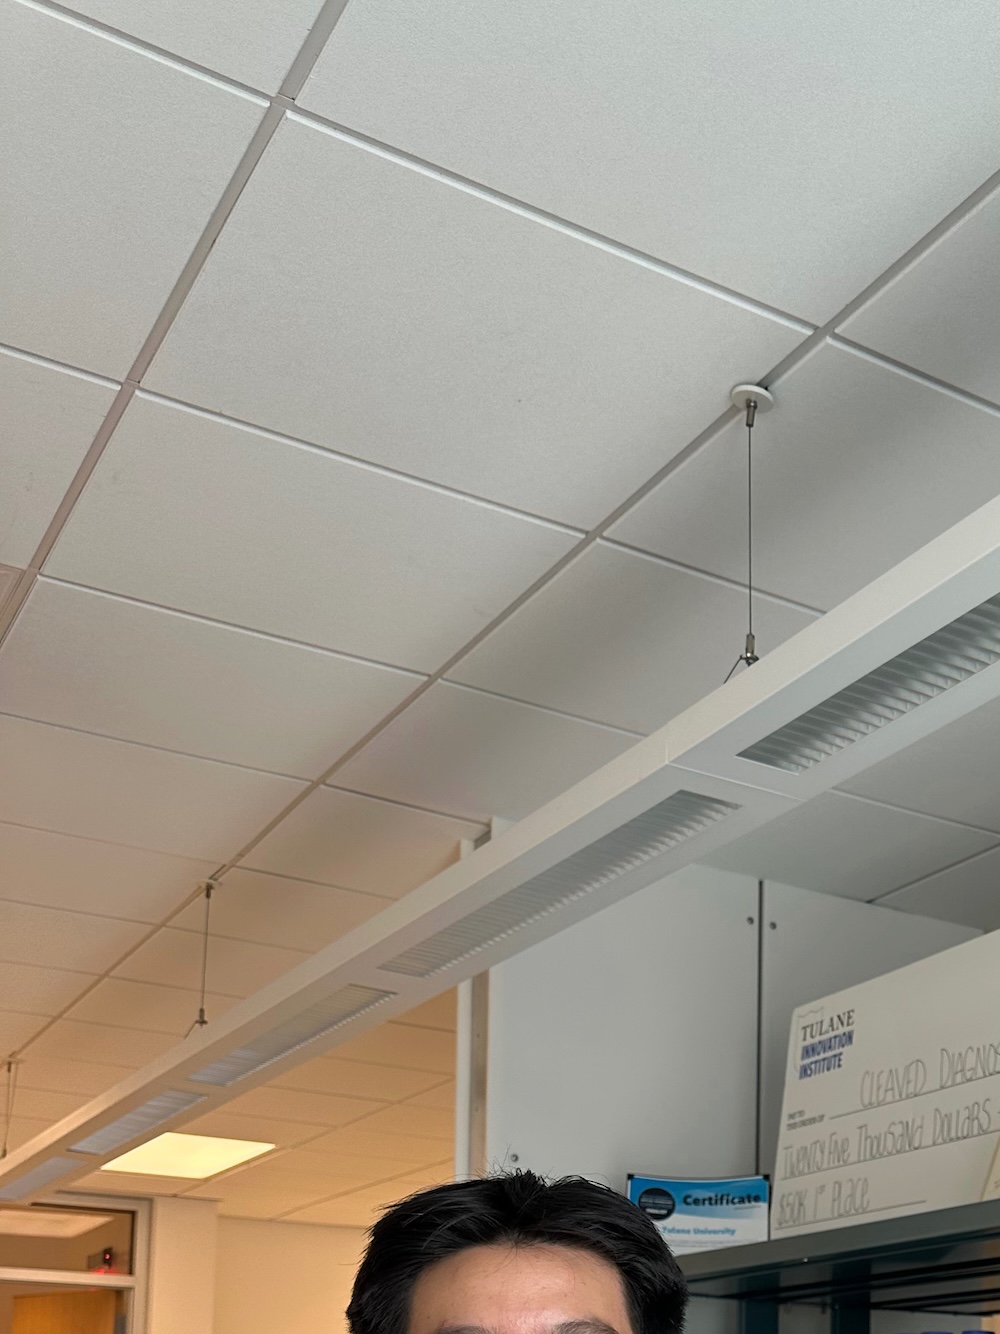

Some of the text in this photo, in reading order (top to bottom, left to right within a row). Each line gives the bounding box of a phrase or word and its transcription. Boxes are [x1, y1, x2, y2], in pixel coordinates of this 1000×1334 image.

[801, 1009, 855, 1042] TULANE
[800, 1029, 854, 1061] INNOVATION
[798, 1052, 843, 1080] INSTITUTE
[683, 1193, 761, 1207] Certificate
[693, 1227, 737, 1236] University
